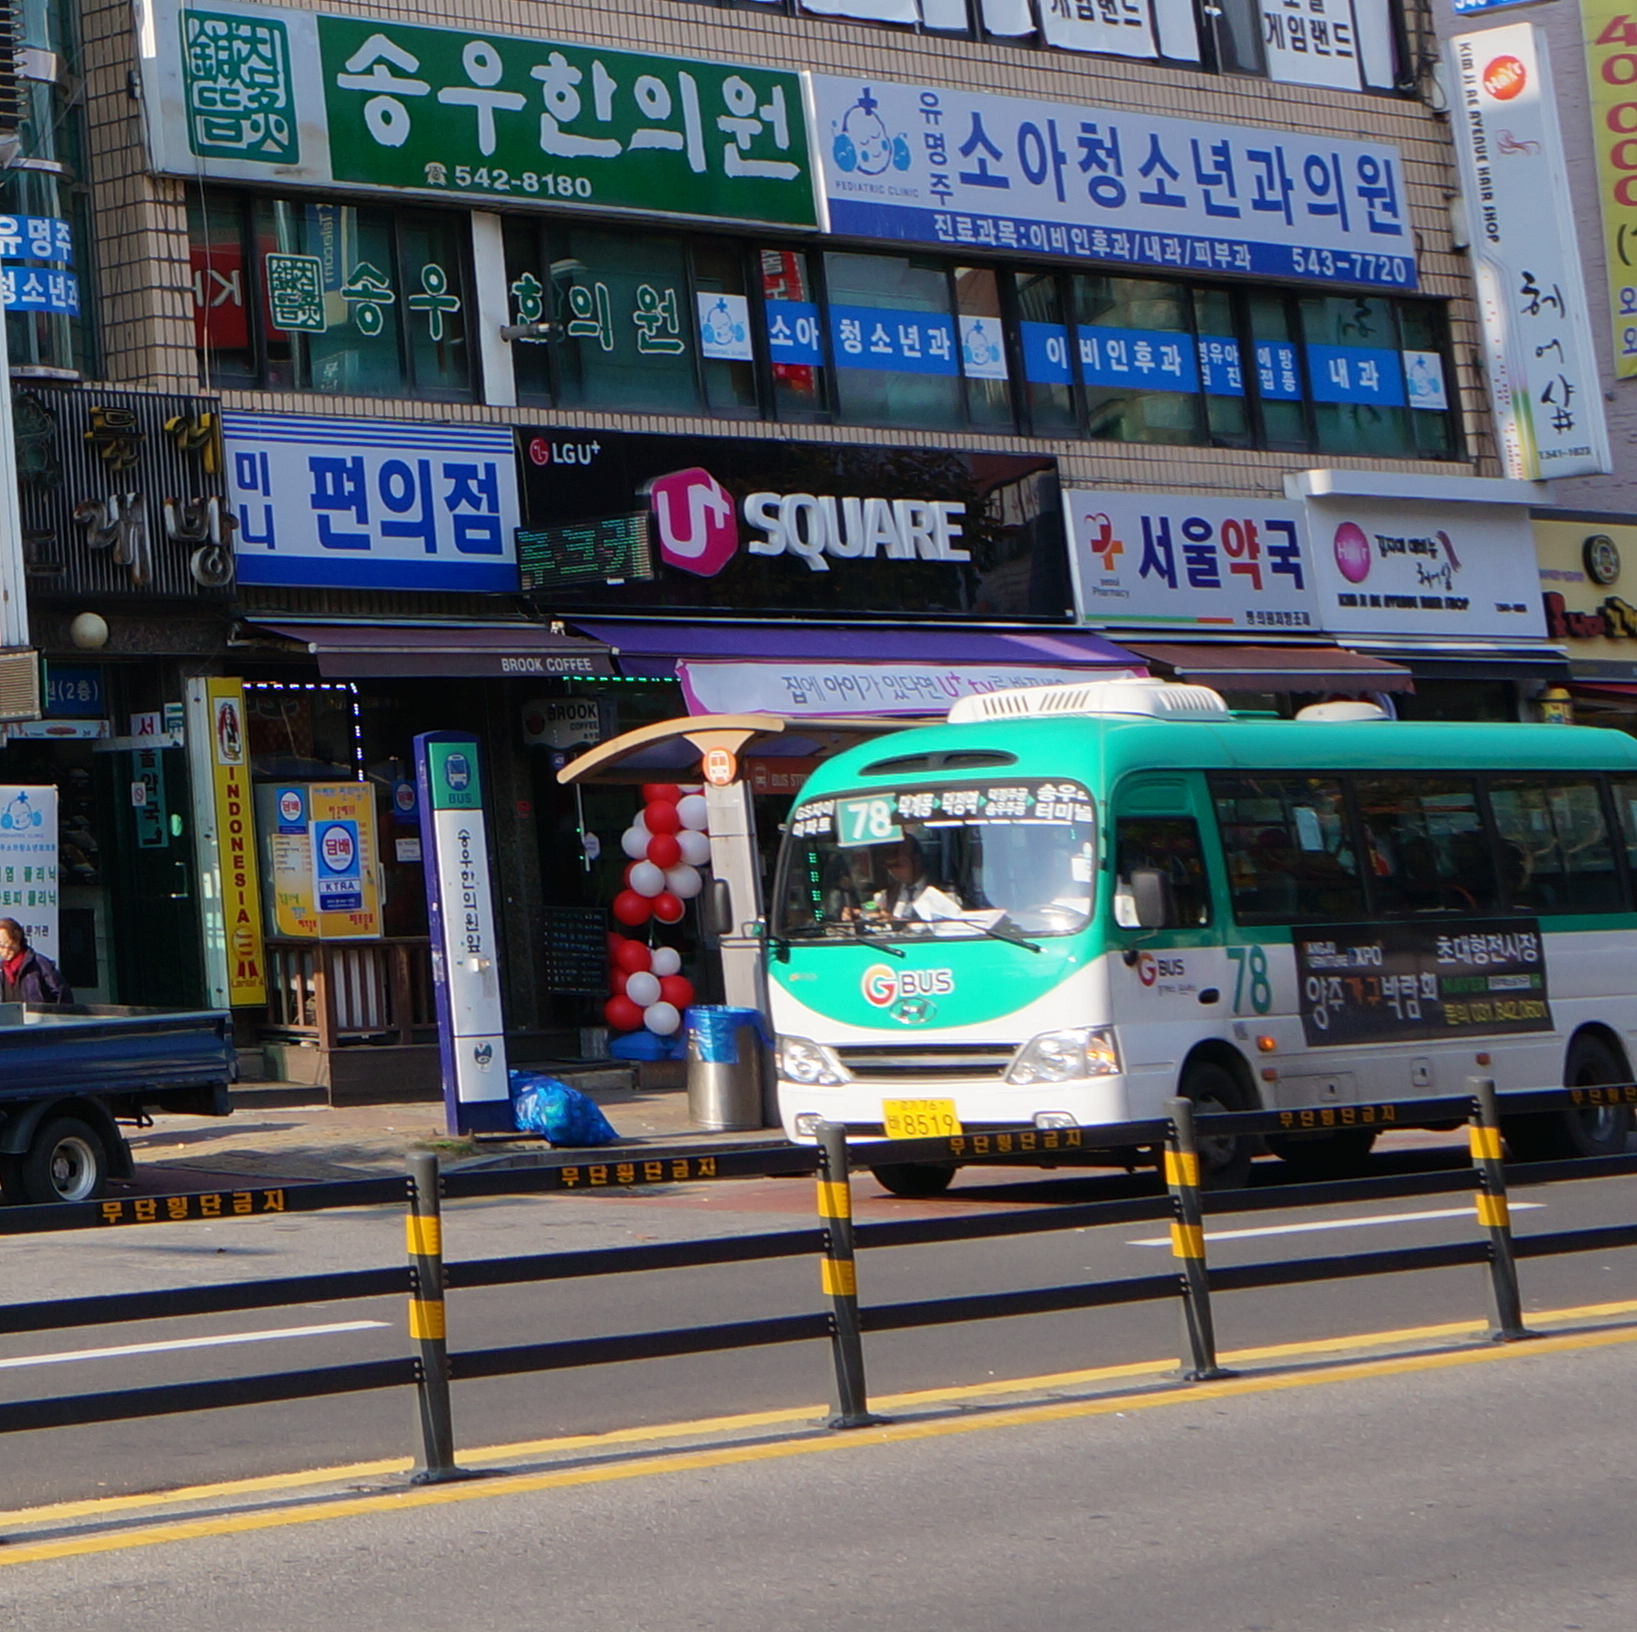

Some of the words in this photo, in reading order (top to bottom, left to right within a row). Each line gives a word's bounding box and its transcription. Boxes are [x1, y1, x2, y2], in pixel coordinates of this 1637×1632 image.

[1263, 10, 1355, 62] 게임랜드
[336, 33, 800, 180] 송우한의원
[918, 91, 955, 207] 유명주
[454, 165, 593, 198] 542-8180
[958, 111, 1405, 237] 소아청소년과의원
[1483, 205, 1501, 244] SHOP
[1291, 250, 1406, 285] 543-7720
[839, 319, 951, 361] 청소년과
[1328, 358, 1380, 392] 내과
[234, 451, 276, 551] 미니
[309, 451, 505, 556] 편의점
[744, 490, 972, 573] SQUARE
[1139, 516, 1305, 590] 서울약국
[501, 657, 543, 673] BROOK
[545, 655, 593, 672] COFFEE
[781, 675, 825, 705] 집에
[825, 674, 883, 703] 아이가
[883, 674, 936, 702] 있다면
[448, 792, 473, 805] BUS
[790, 773, 810, 787] STO
[847, 800, 892, 841] 78
[227, 766, 251, 924] INDONESIA
[326, 838, 351, 856] 담배
[458, 828, 482, 954] 송우한의원앞
[1436, 932, 1538, 967] 초대형전시장
[1226, 944, 1274, 1016] 78
[560, 1157, 719, 1188] 무단횡단금지
[100, 1188, 287, 1225] 무단횡단금지
